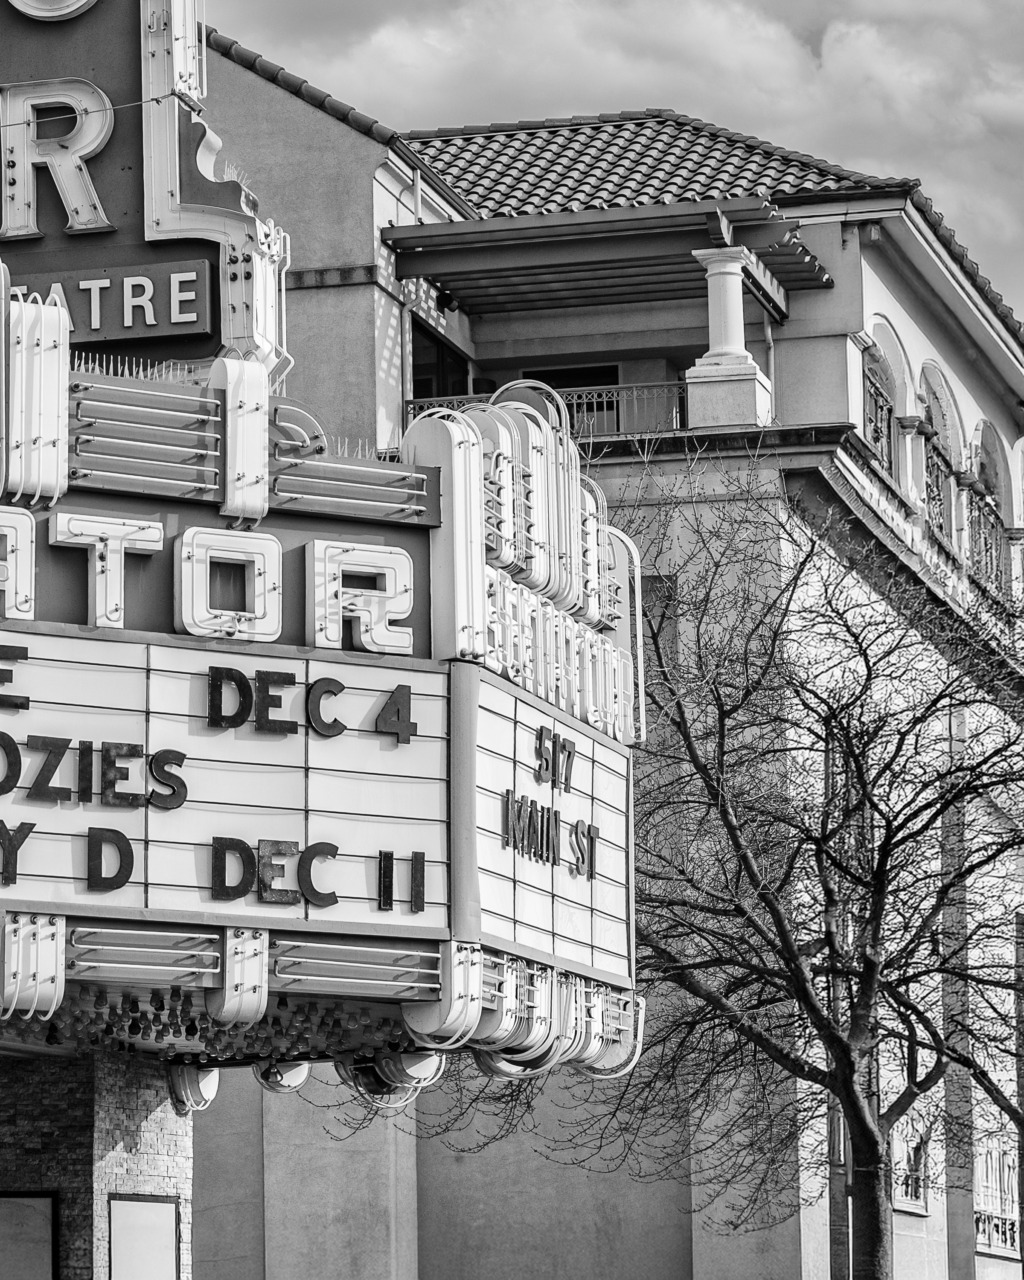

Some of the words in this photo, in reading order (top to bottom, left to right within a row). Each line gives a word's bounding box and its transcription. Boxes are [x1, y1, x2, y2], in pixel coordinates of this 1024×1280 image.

[207, 665, 347, 738] DEC
[375, 684, 418, 745] 4
[537, 725, 576, 794] 517
[86, 826, 135, 893] D
[211, 835, 340, 908] DEC
[505, 788, 561, 867] MAIN
[574, 819, 600, 880] ST
